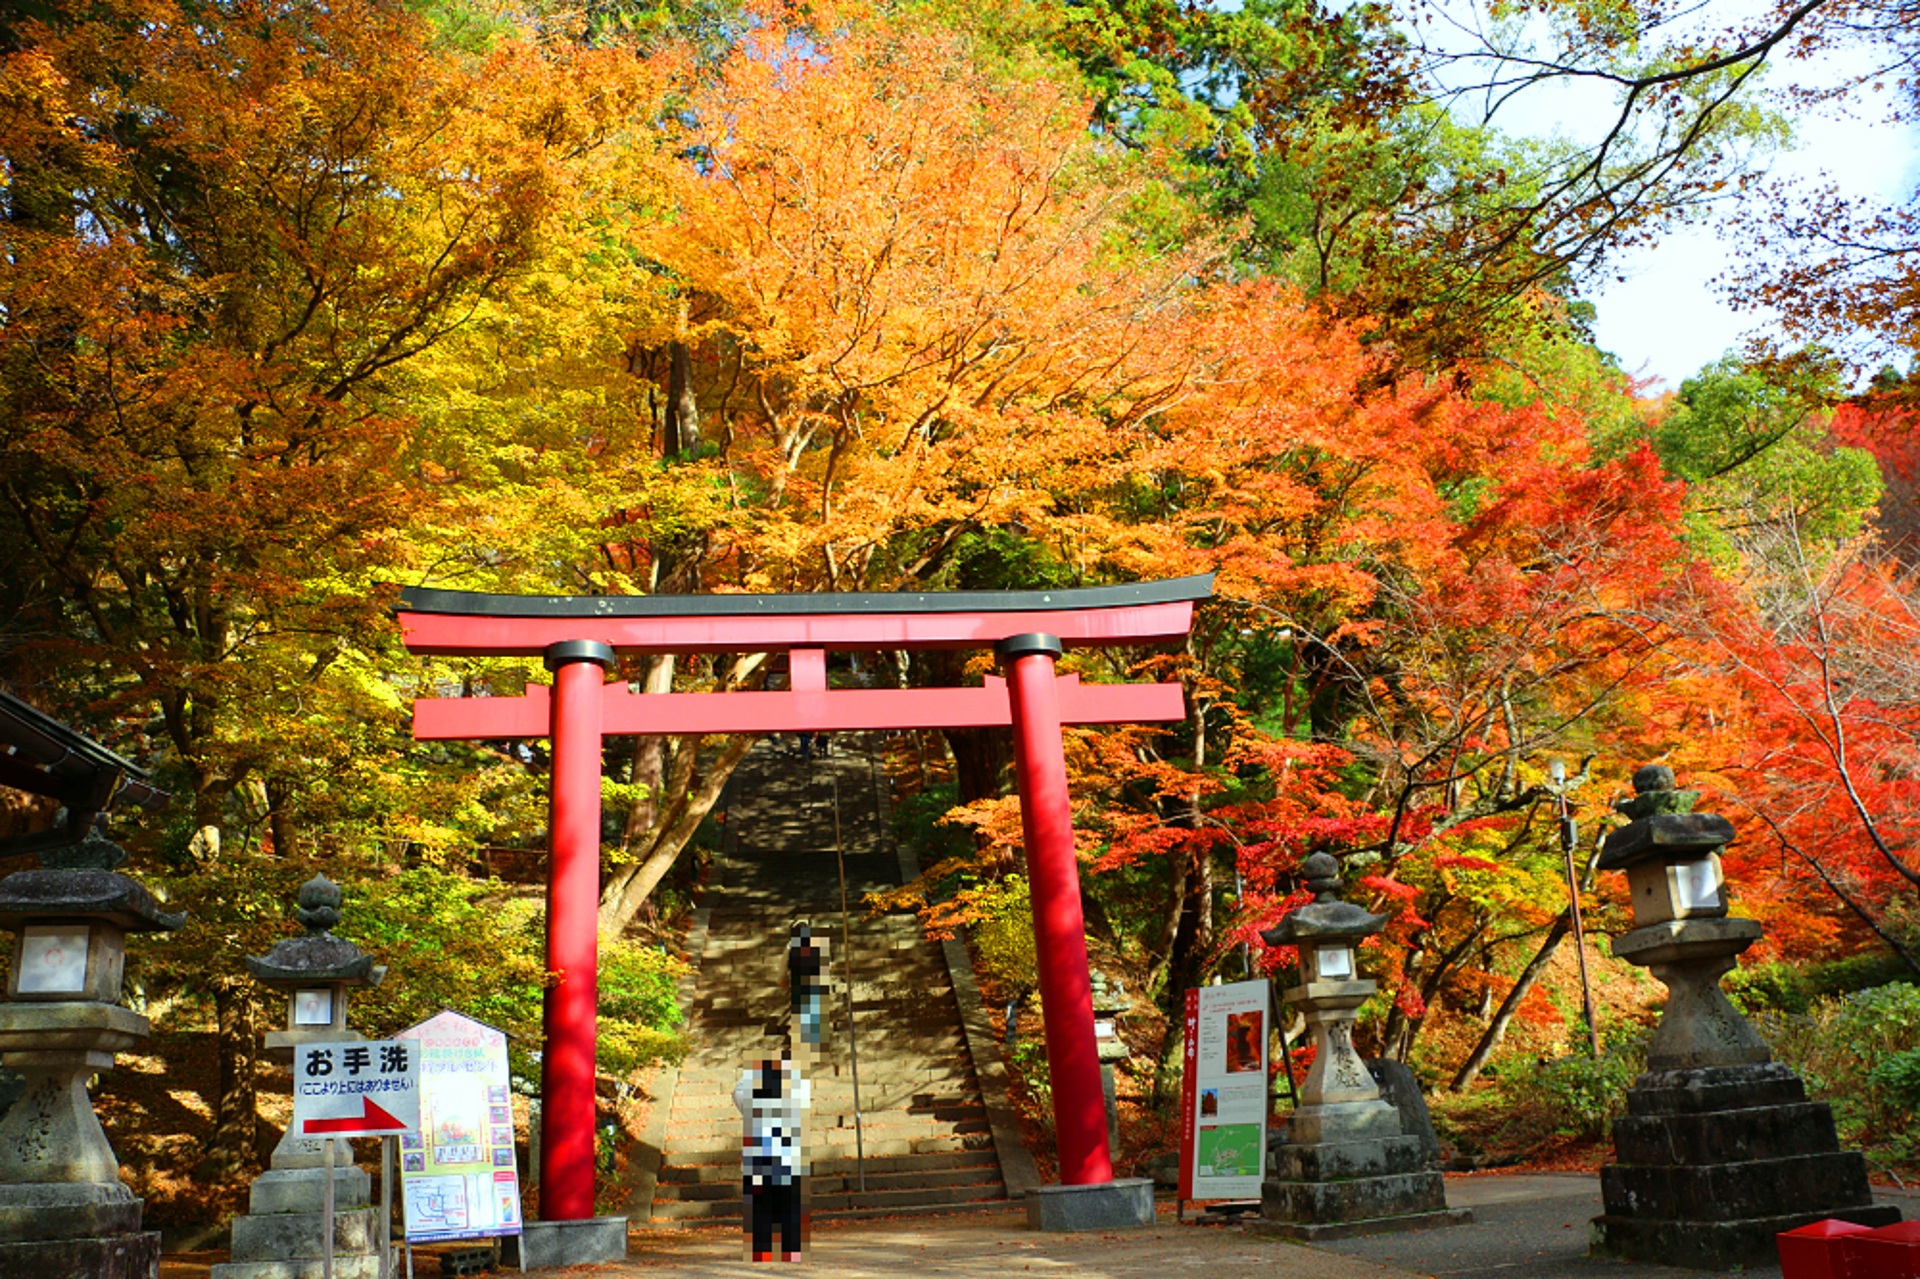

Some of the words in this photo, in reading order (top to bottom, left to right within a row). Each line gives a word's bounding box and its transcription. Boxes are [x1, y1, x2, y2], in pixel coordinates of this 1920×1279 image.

[305, 1045, 408, 1076] お手洗
[299, 1078, 414, 1095] （ここより上にはありません）
